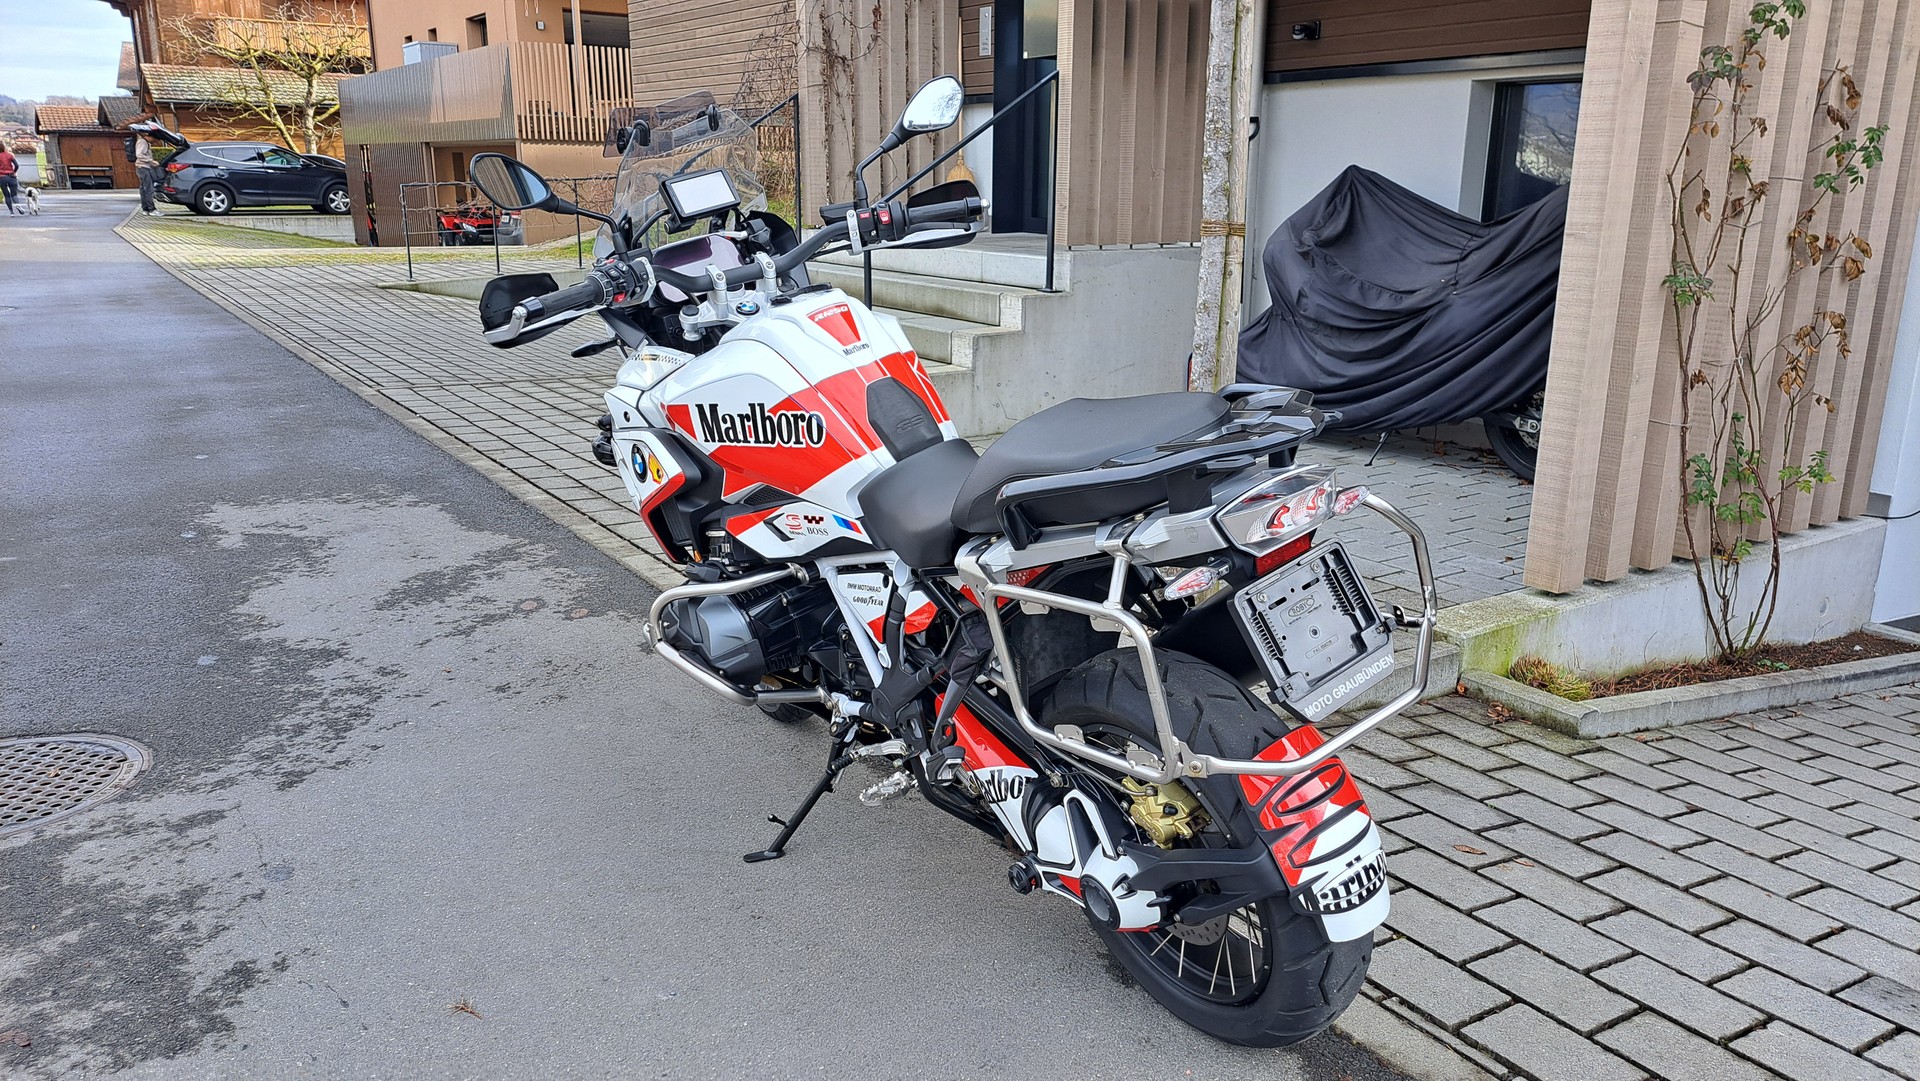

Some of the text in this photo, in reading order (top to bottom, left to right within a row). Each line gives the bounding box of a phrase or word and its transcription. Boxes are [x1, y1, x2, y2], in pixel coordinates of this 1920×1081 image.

[842, 343, 870, 356] Marlboro
[695, 402, 824, 446] Marlboro
[806, 526, 829, 537] BOSS
[847, 582, 882, 593] BMW MOTORRAD
[852, 595, 884, 607] GOODYEAR
[1291, 599, 1312, 616] ROBYC
[1304, 654, 1394, 718] MOTO GRAUBÜNDEN
